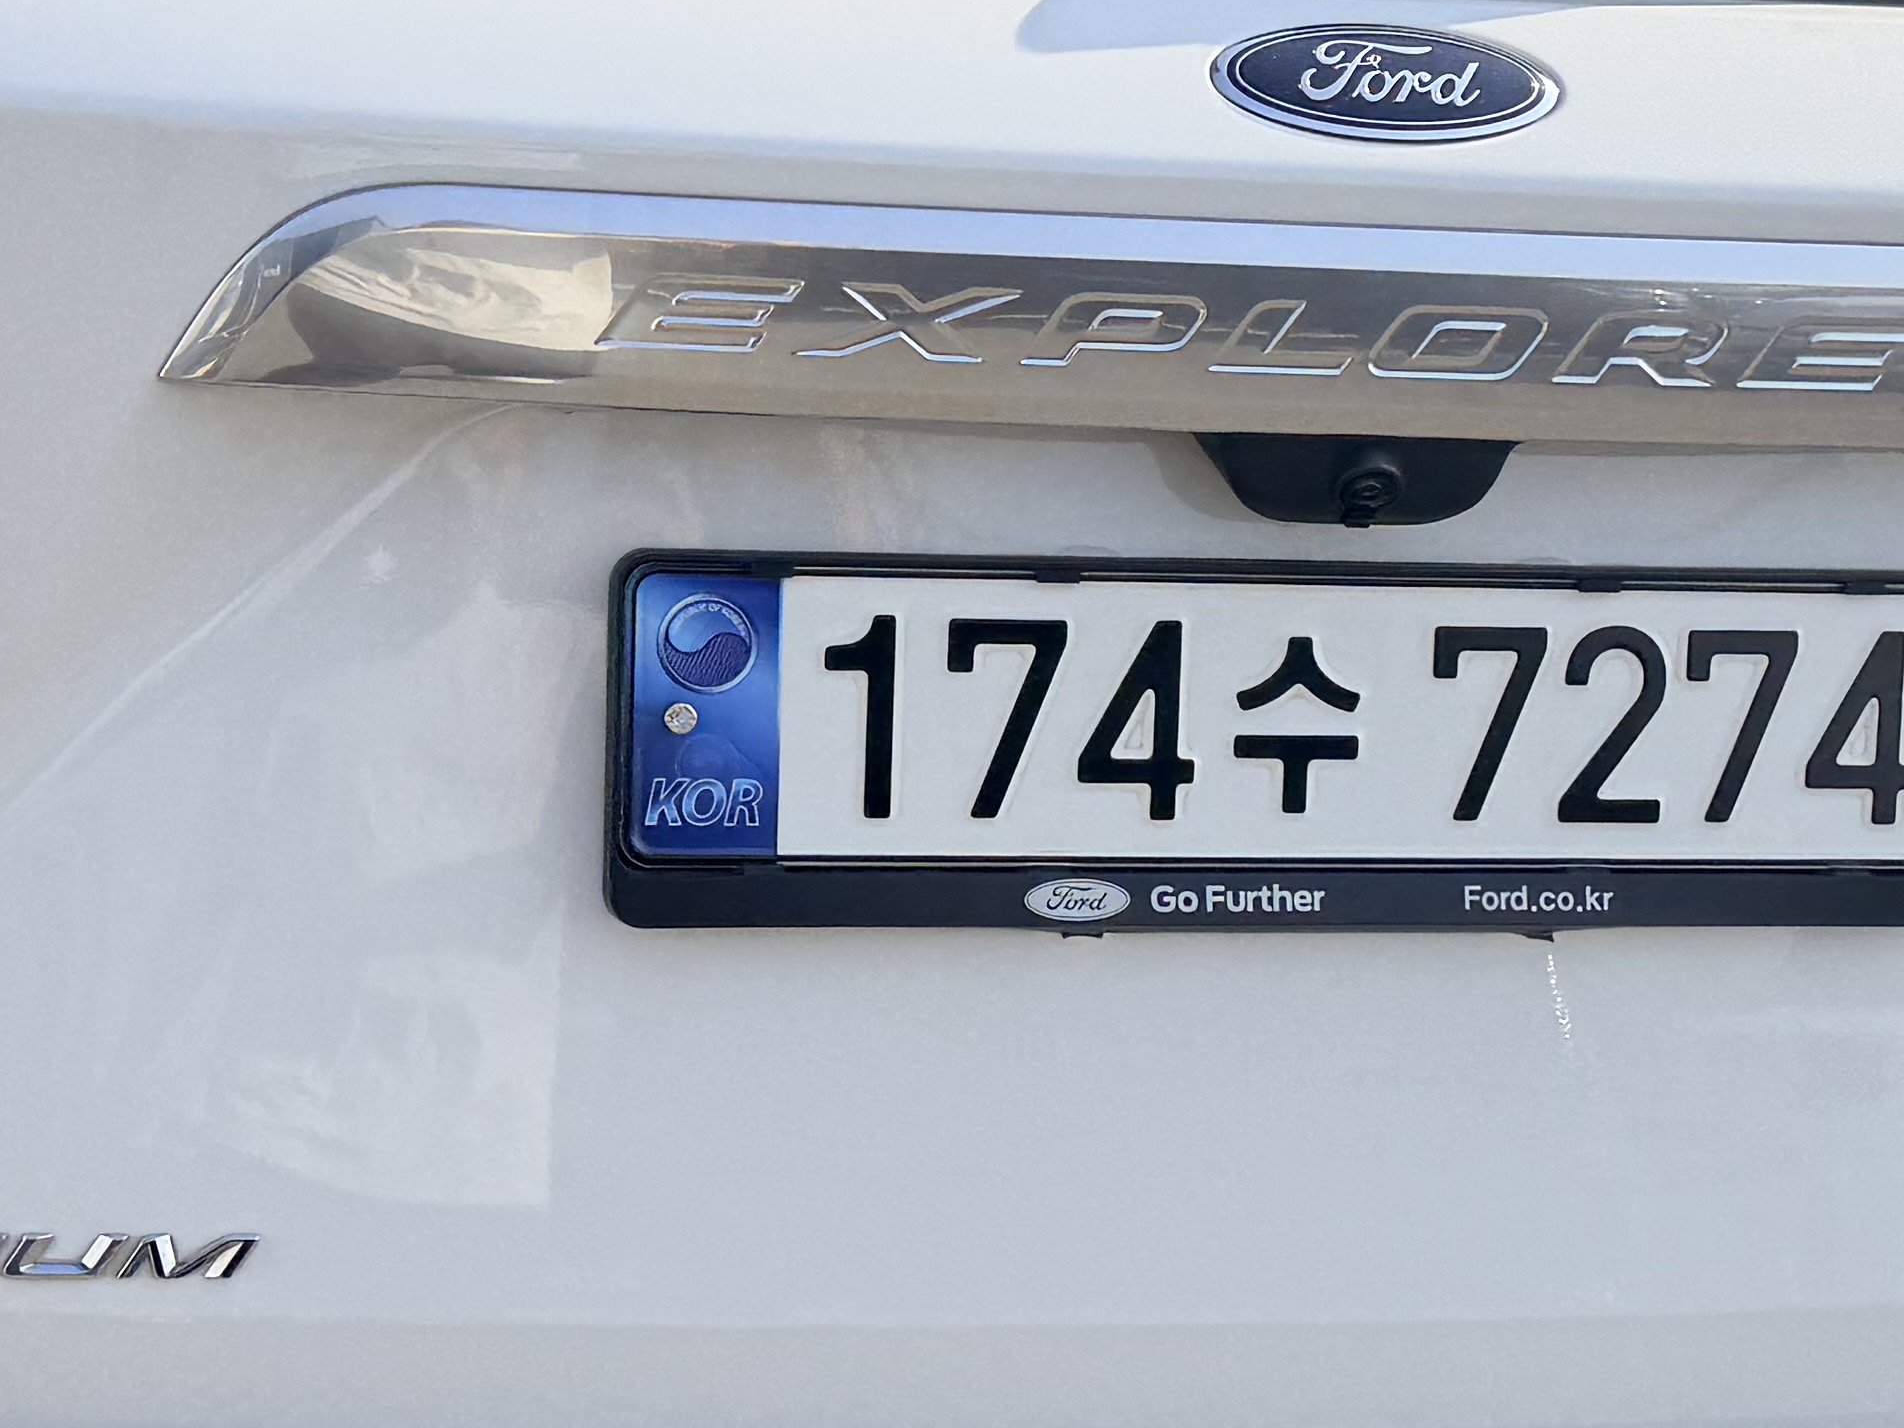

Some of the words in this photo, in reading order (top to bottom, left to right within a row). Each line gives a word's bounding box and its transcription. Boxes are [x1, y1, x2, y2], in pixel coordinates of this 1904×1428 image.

[1298, 38, 1481, 108] Ford
[824, 613, 1361, 822] 174수
[645, 778, 764, 827] KOR
[1045, 884, 1108, 912] Ford
[1150, 887, 1198, 914] Go
[1206, 884, 1326, 914] Further
[1464, 884, 1615, 913] Ford.co.kr
